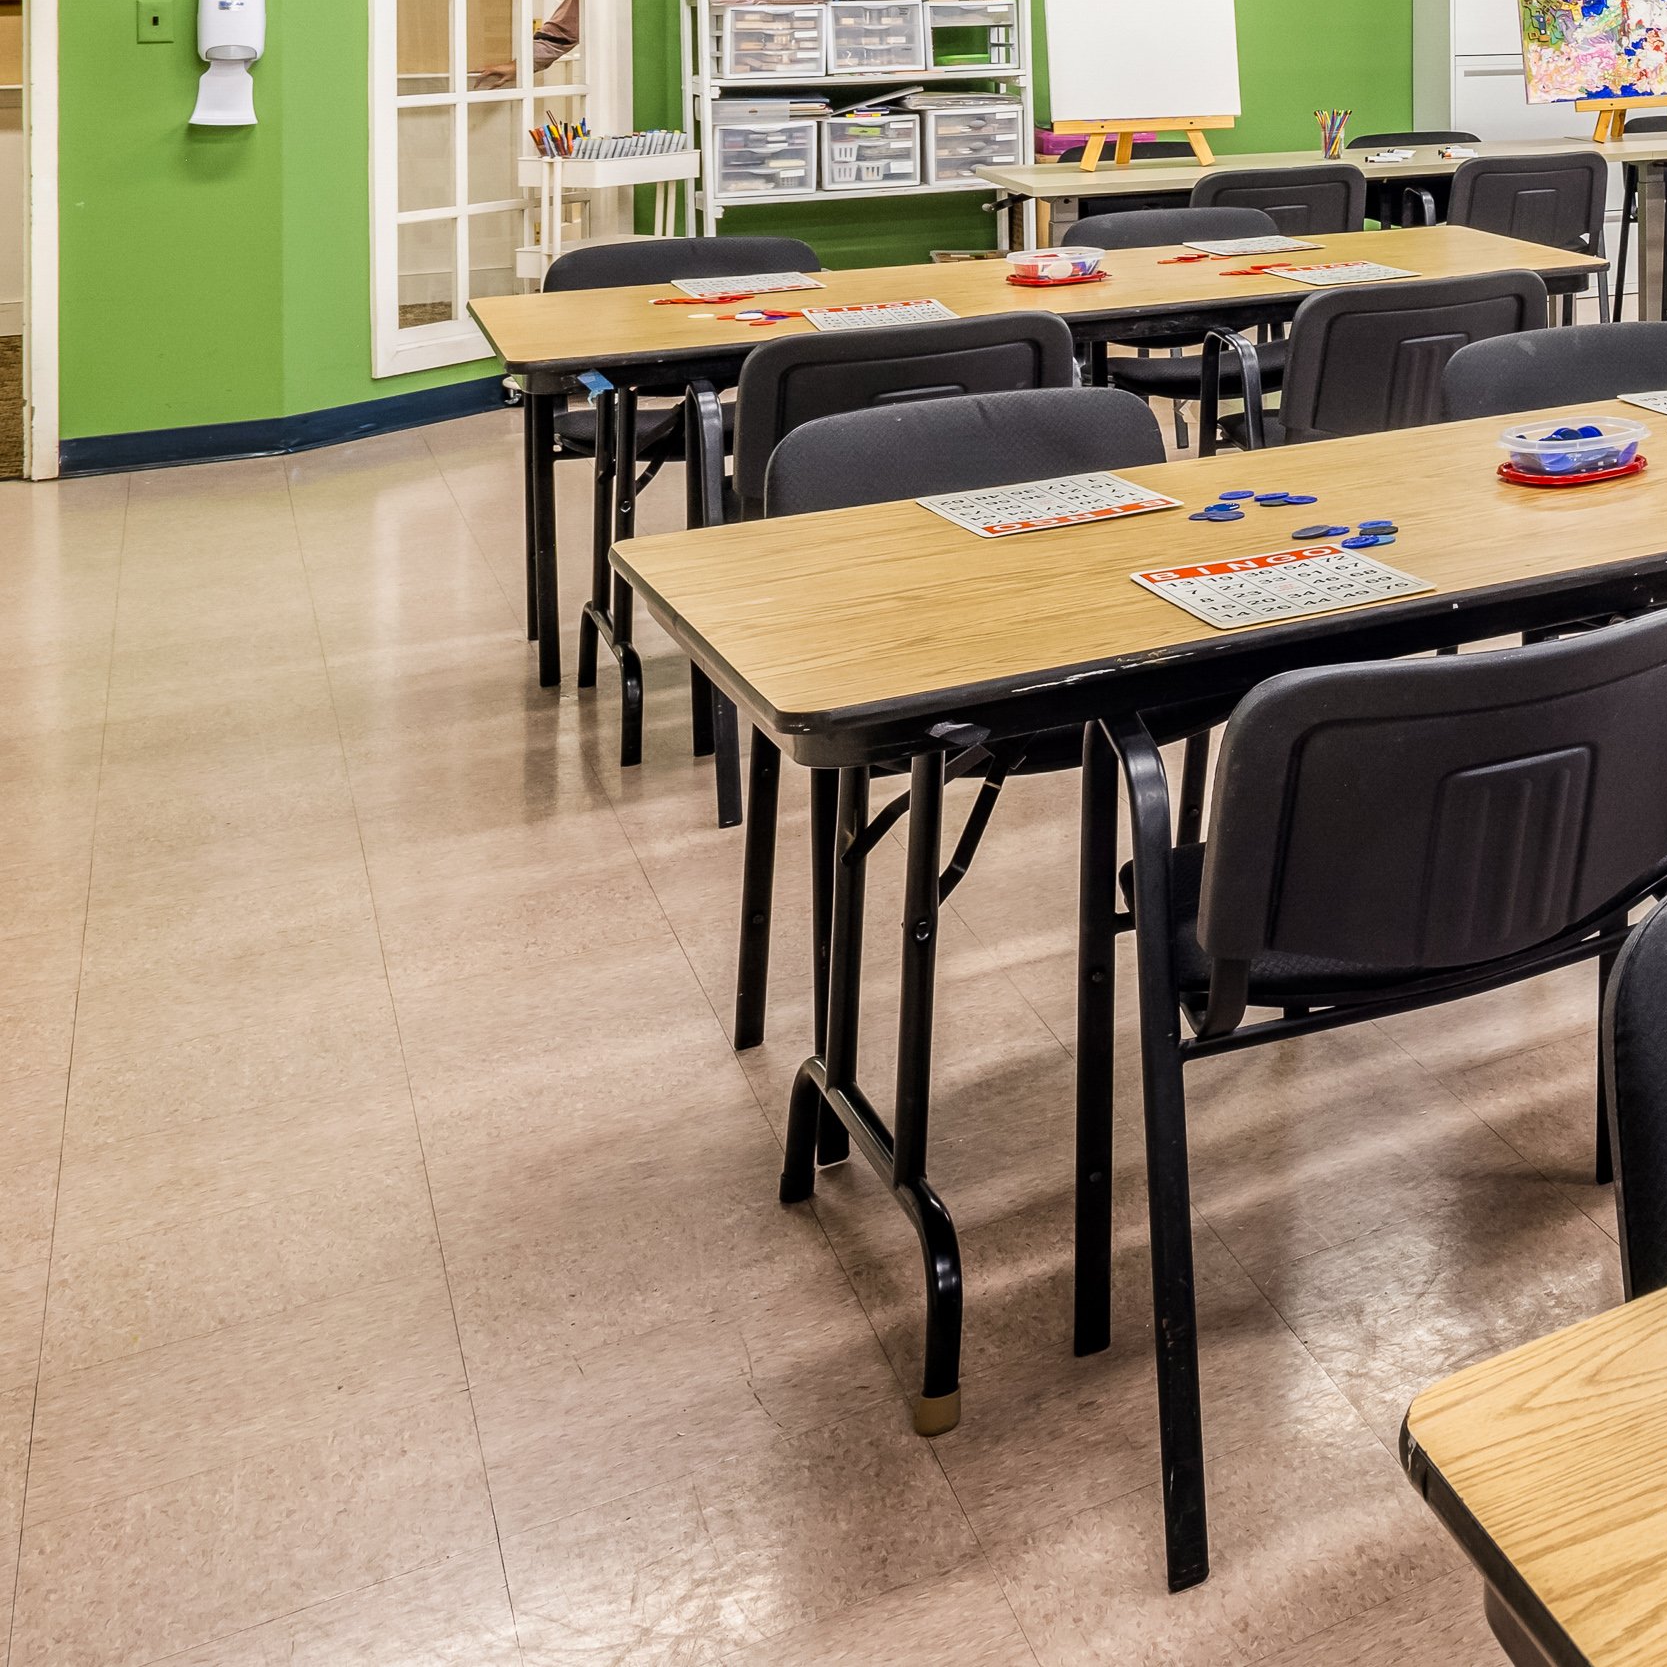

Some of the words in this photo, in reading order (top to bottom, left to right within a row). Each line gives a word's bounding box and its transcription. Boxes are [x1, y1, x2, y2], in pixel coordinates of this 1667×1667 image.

[992, 498, 1167, 531] BINGO
[1154, 546, 1334, 583] BINGO
[1303, 597, 1331, 605] 44
